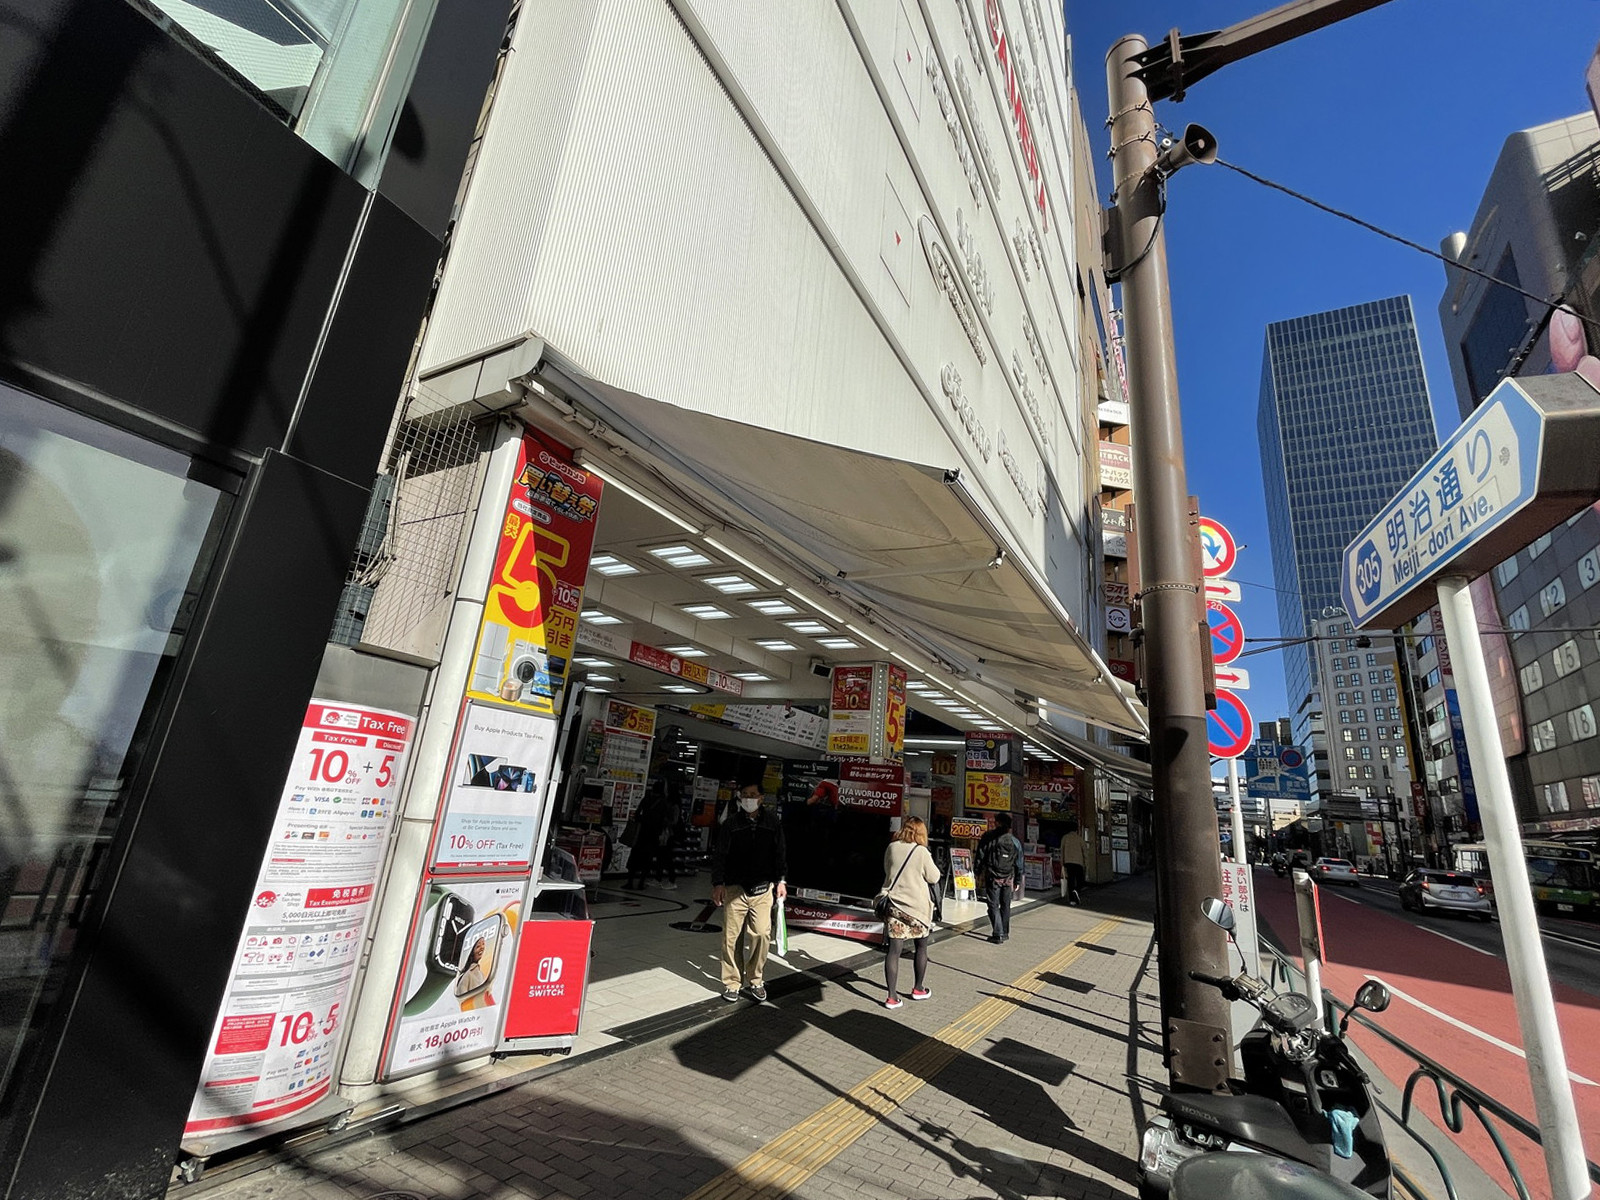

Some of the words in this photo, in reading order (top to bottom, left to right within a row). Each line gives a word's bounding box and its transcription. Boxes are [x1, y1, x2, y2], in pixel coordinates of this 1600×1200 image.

[1385, 428, 1493, 559] 明治通り
[504, 513, 521, 539] 最大
[1391, 516, 1455, 585] Meiji-dori
[1458, 495, 1494, 534] Ave.
[491, 522, 571, 629] 5
[1357, 550, 1382, 596] 305
[1550, 586, 1562, 607] 2
[549, 608, 576, 632] 万円
[546, 628, 572, 649] 引き
[361, 716, 385, 731] Tax
[386, 721, 406, 735] Free
[485, 726, 501, 735] Apple
[501, 728, 524, 738] Products
[323, 734, 339, 742] Tax
[340, 736, 358, 745] Free
[309, 748, 349, 783] 10
[375, 755, 396, 788] 5
[839, 786, 857, 795] FIFA
[855, 788, 881, 798] WORLD
[881, 791, 898, 800] CUP
[1047, 782, 1062, 793] 70
[450, 834, 474, 850] 10%
[476, 839, 496, 850] OFF
[495, 842, 508, 850] (Tax
[508, 842, 524, 850] Free)
[1236, 867, 1249, 912] 赤い部分は
[528, 989, 564, 998] SWITCH
[280, 1011, 314, 1047] 10
[440, 1019, 457, 1030] Apple
[457, 1016, 477, 1026] Watch
[424, 1027, 469, 1050] 18,000
[1180, 1105, 1220, 1125] HONDA
